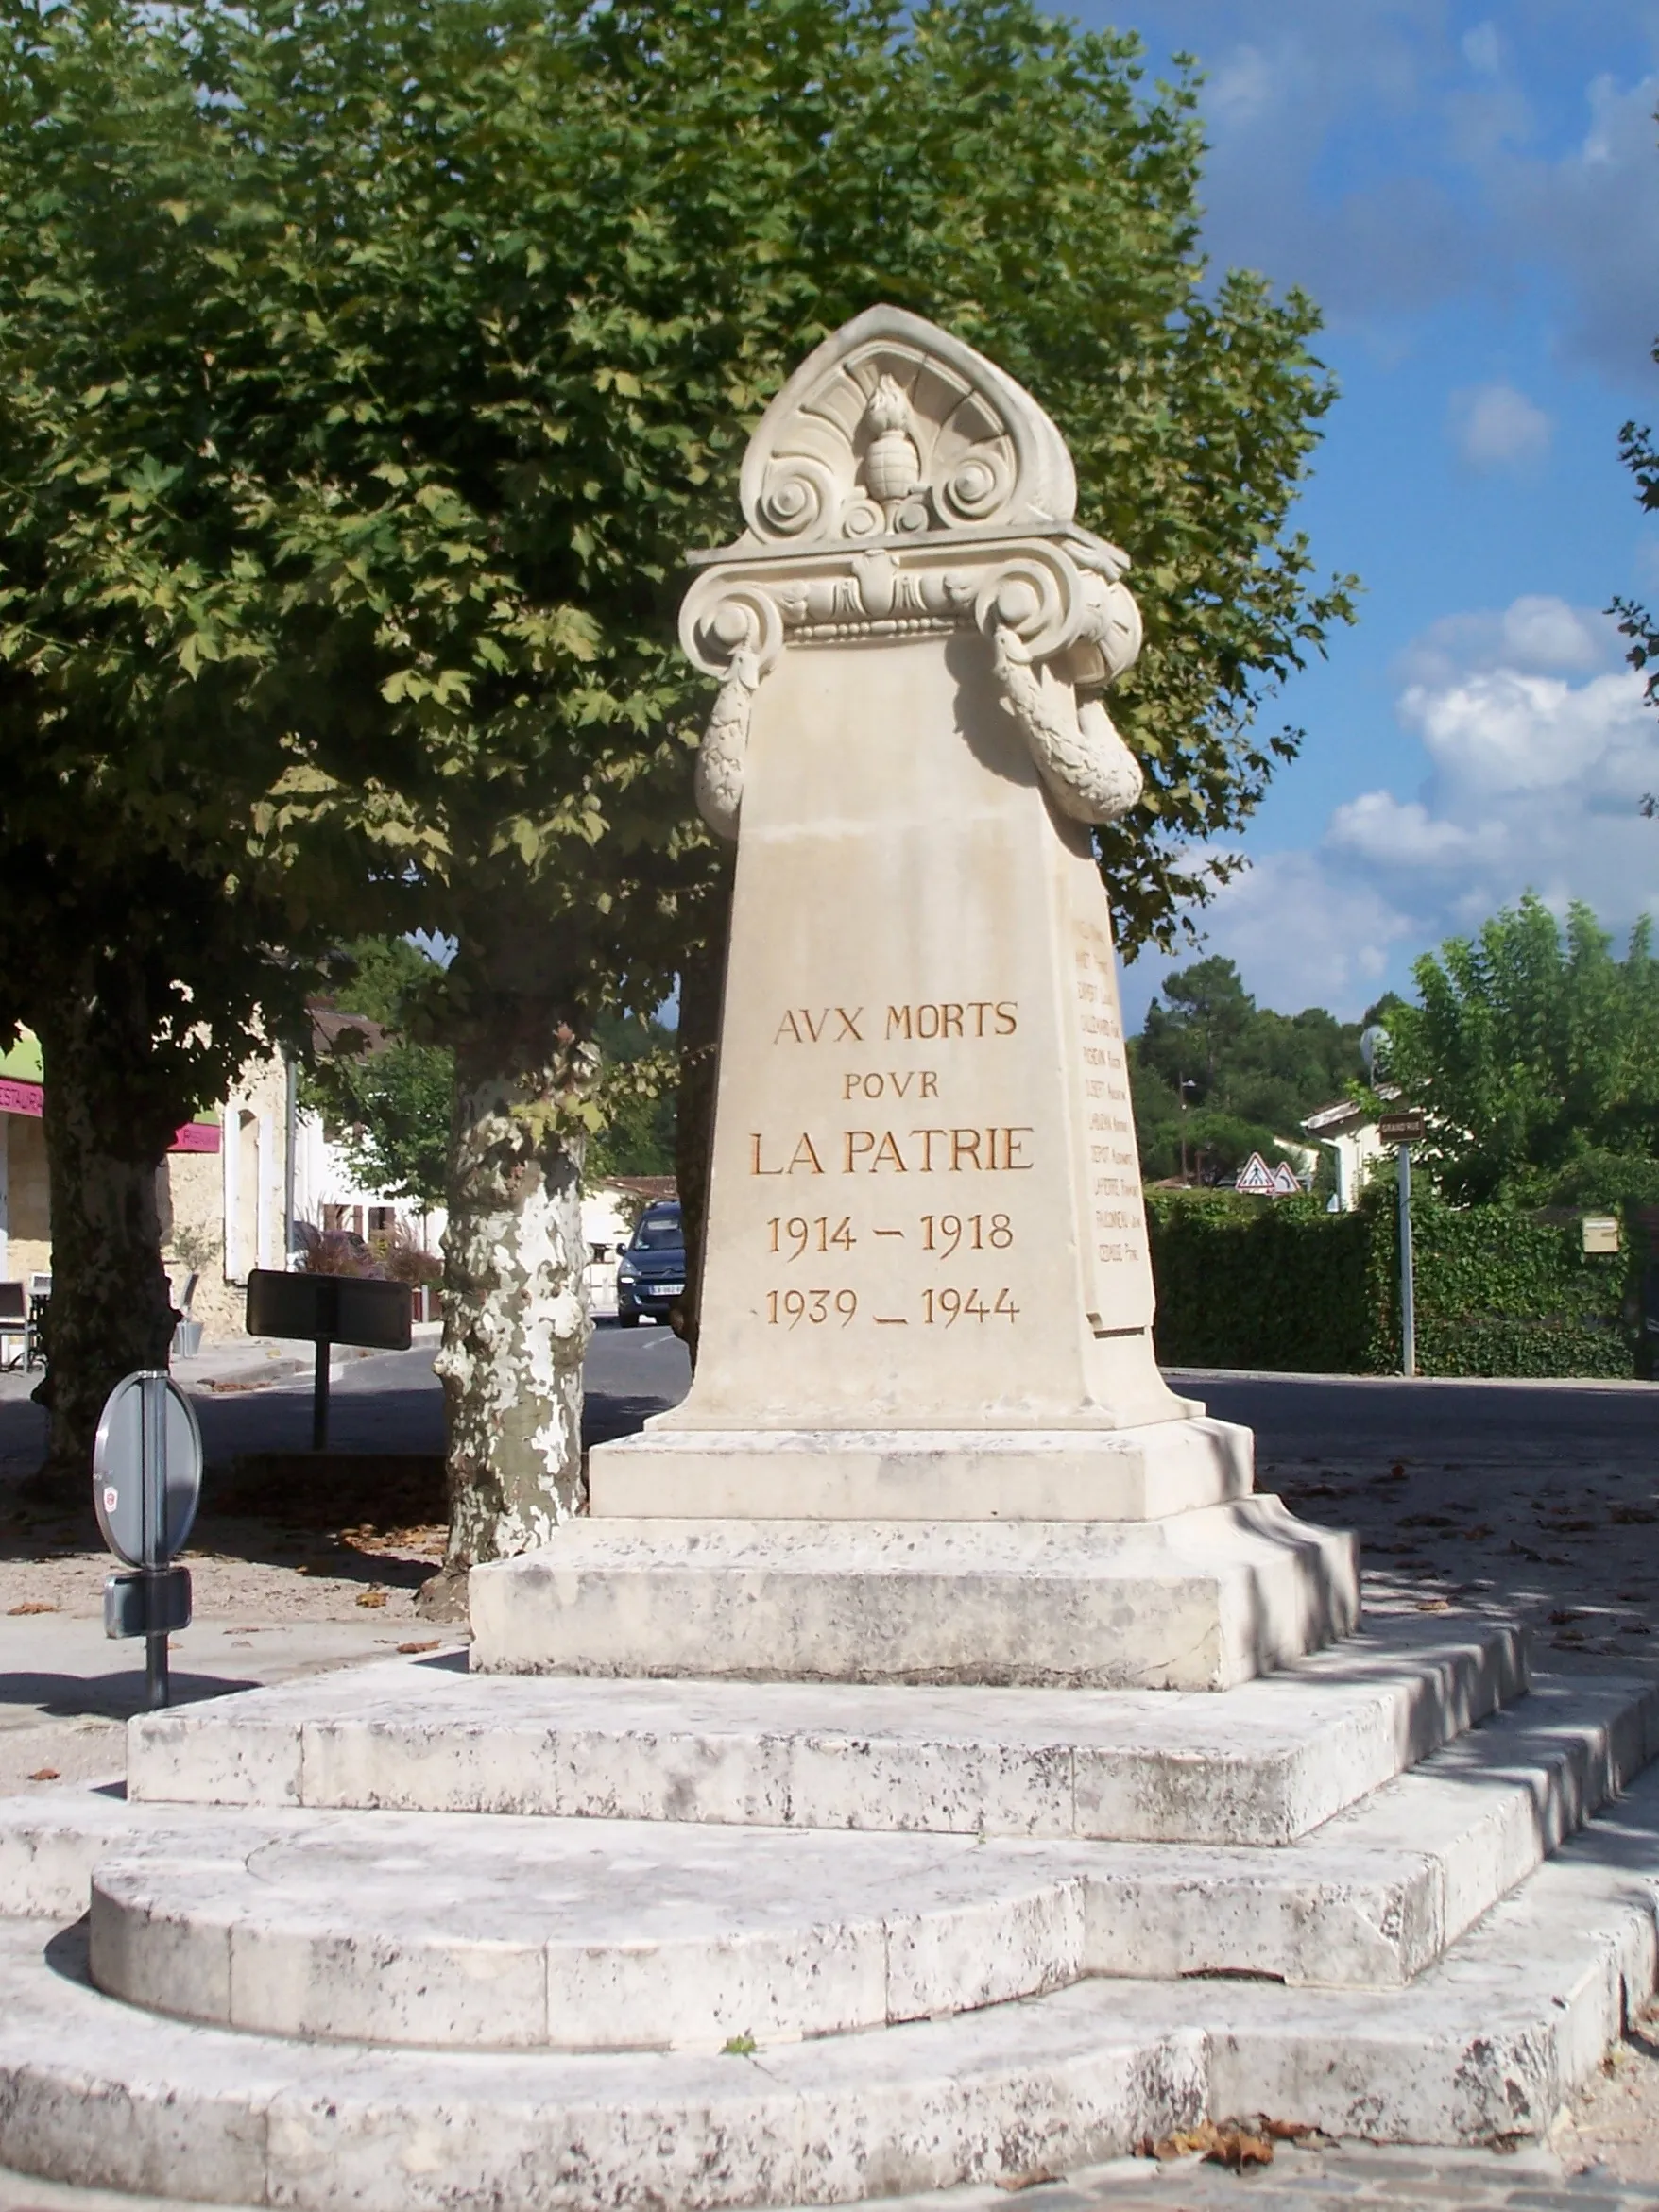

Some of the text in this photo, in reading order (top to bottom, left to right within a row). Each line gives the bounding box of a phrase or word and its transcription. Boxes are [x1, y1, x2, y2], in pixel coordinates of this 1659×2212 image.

[774, 1000, 1018, 1045] AVX MORTS
[842, 1070, 939, 1100] POVR
[749, 1127, 1035, 1176] LA PATRIE
[766, 1216, 858, 1263] 1914
[919, 1213, 1014, 1260] 1918
[765, 1288, 858, 1331] 1939
[921, 1287, 1021, 1329] 1944
